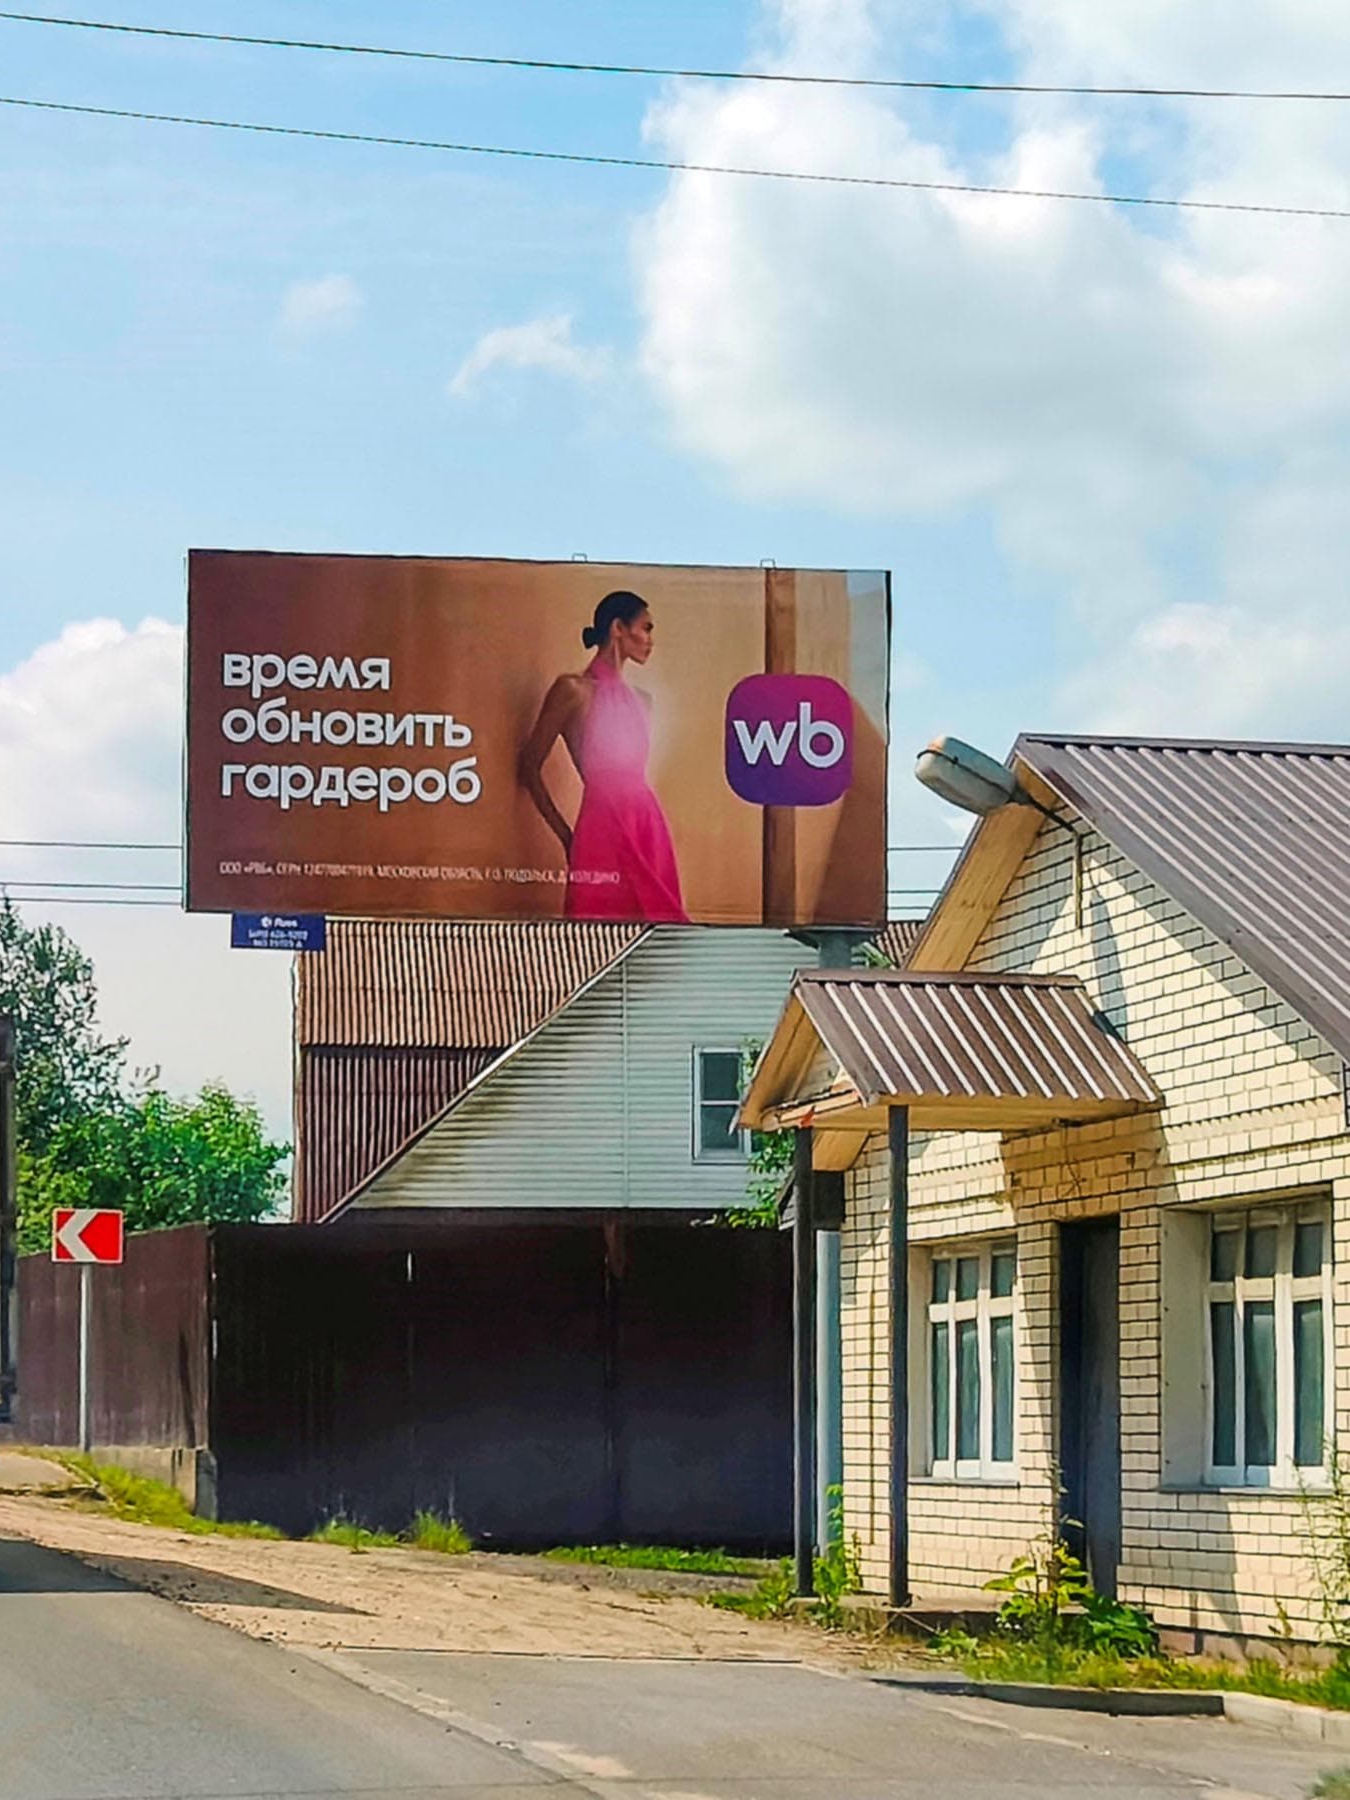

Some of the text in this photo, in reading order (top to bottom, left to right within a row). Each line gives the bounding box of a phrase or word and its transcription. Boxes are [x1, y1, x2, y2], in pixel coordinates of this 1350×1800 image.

[222, 652, 391, 698] время
[221, 697, 473, 749] обновить
[732, 702, 845, 769] wb
[221, 757, 482, 811] гардероб
